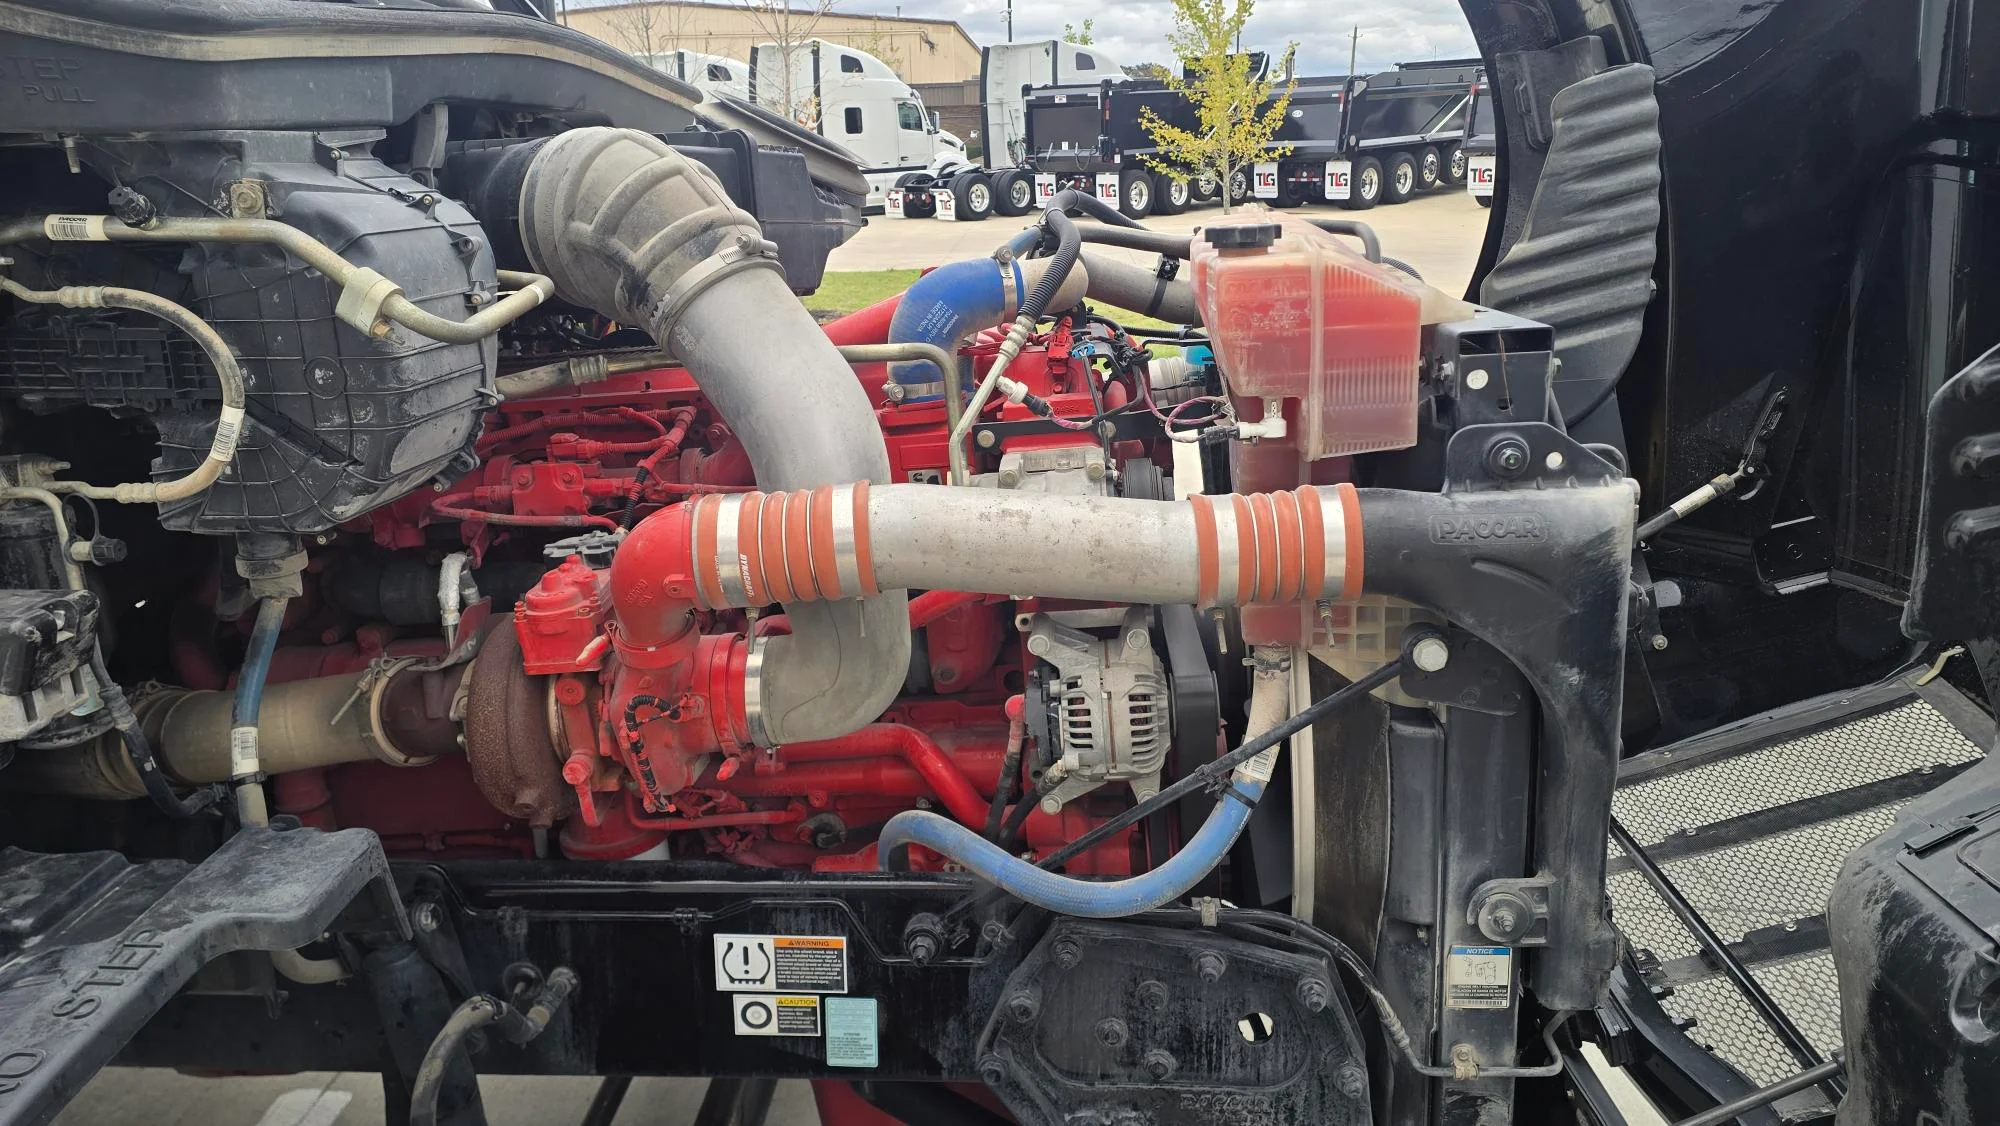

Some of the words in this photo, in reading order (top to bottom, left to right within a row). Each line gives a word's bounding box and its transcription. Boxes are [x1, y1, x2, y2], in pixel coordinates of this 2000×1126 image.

[22, 84, 97, 104] PULL
[1256, 172, 1276, 187] TLG
[1327, 172, 1348, 187] TLG
[1470, 168, 1493, 183] TLG
[1037, 182, 1054, 197] TLG
[1098, 183, 1117, 197] TLG
[888, 198, 900, 208] TLG
[939, 199, 952, 210] TLG
[1437, 517, 1541, 540] PACCAR
[52, 929, 164, 1020] STEP
